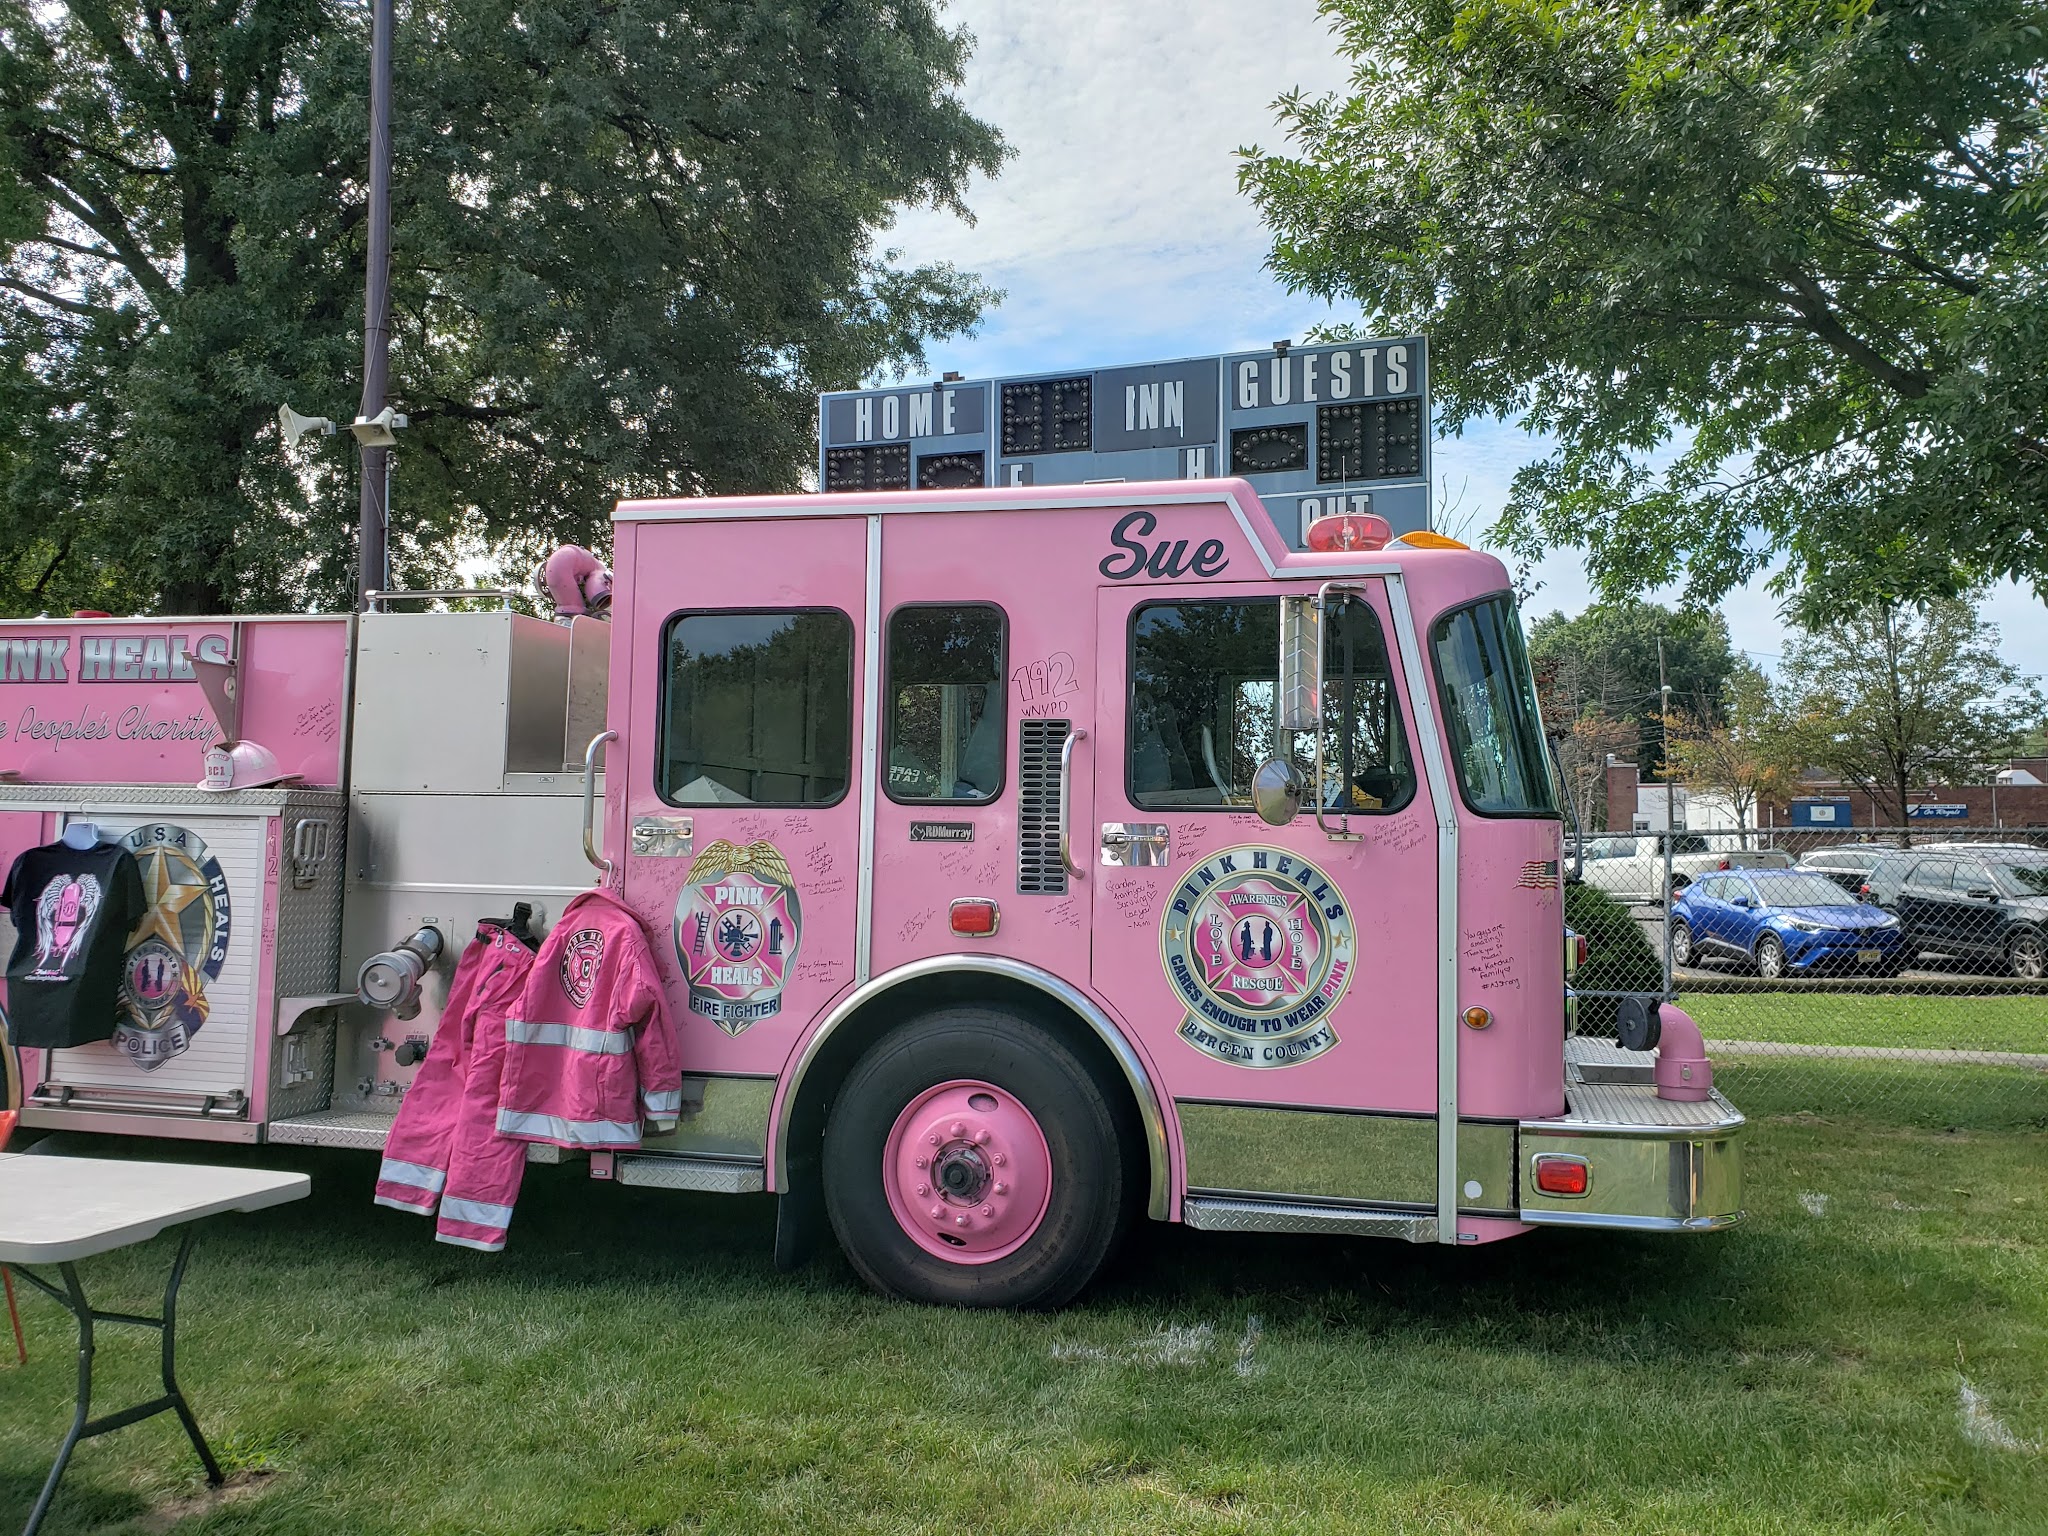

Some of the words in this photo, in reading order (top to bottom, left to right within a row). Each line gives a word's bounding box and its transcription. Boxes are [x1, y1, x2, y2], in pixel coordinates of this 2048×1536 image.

[1238, 345, 1408, 409] GUESTS
[855, 390, 956, 442] HOME
[1125, 380, 1184, 438] INN
[1186, 448, 1206, 480] H
[1099, 510, 1230, 580] Sue
[79, 634, 229, 684] HEALS
[1011, 651, 1080, 702] 192
[14, 704, 112, 753] People's
[116, 704, 220, 754] Charity
[925, 825, 971, 841] RDMurray
[714, 886, 765, 906] PINK
[1173, 855, 1237, 916] PINK
[1253, 852, 1344, 920] HEALS
[1228, 893, 1288, 908] AWARENESS
[209, 874, 226, 963] HEALS
[1209, 913, 1223, 966] LOVE
[1288, 918, 1304, 970] HOPE
[711, 966, 764, 986] HEALS
[1170, 954, 1203, 1002] CARES
[1200, 998, 1257, 1033] ENOUGH
[1260, 1017, 1282, 1033] TO
[1284, 995, 1327, 1029] WEAR
[1320, 958, 1349, 998] PINK
[1231, 973, 1284, 991] RESCUE
[693, 996, 720, 1016] FIRE
[723, 998, 778, 1019] FIGHTER
[115, 1032, 185, 1056] POLICE
[1185, 1021, 1255, 1060] BERGEN
[1263, 1027, 1331, 1061] COUNTY
